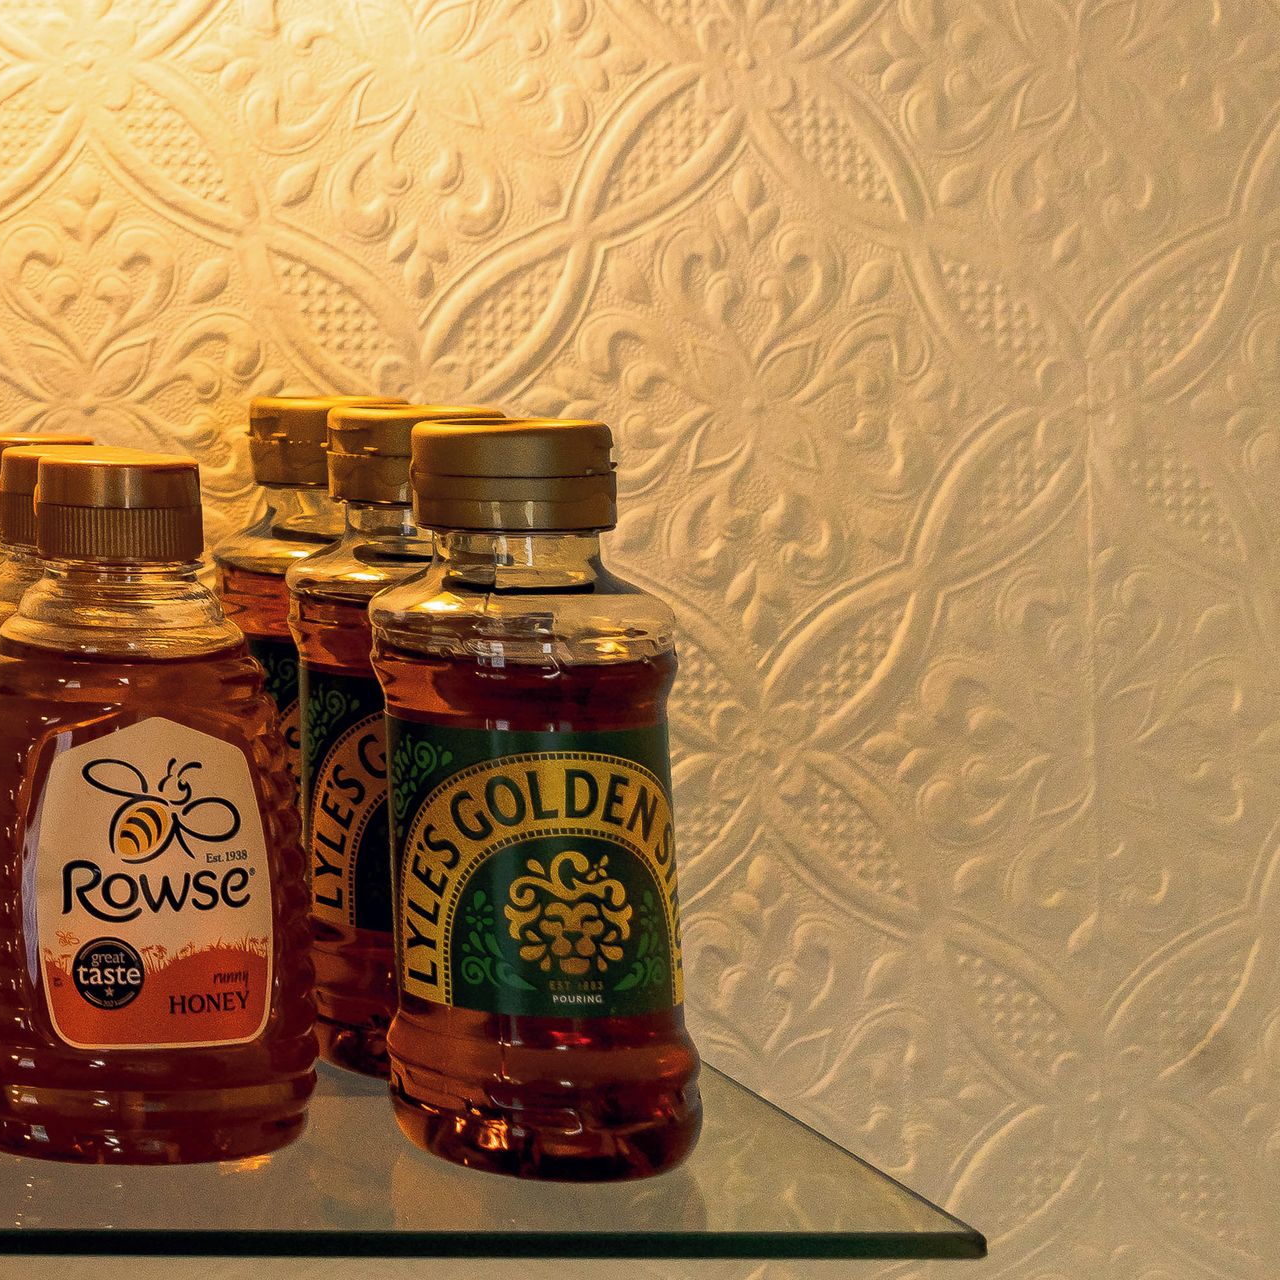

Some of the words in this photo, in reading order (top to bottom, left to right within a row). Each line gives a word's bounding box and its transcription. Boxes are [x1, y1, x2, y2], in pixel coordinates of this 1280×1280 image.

[314, 764, 366, 910] LYLE'S
[406, 822, 462, 987] LYLE'S
[449, 768, 659, 844] GOLDEN
[61, 858, 251, 924] Rowse
[91, 951, 126, 967] great
[77, 965, 141, 986] taste
[212, 969, 249, 990] runny
[169, 990, 250, 1015] HONEY
[552, 994, 603, 1004] POURING
